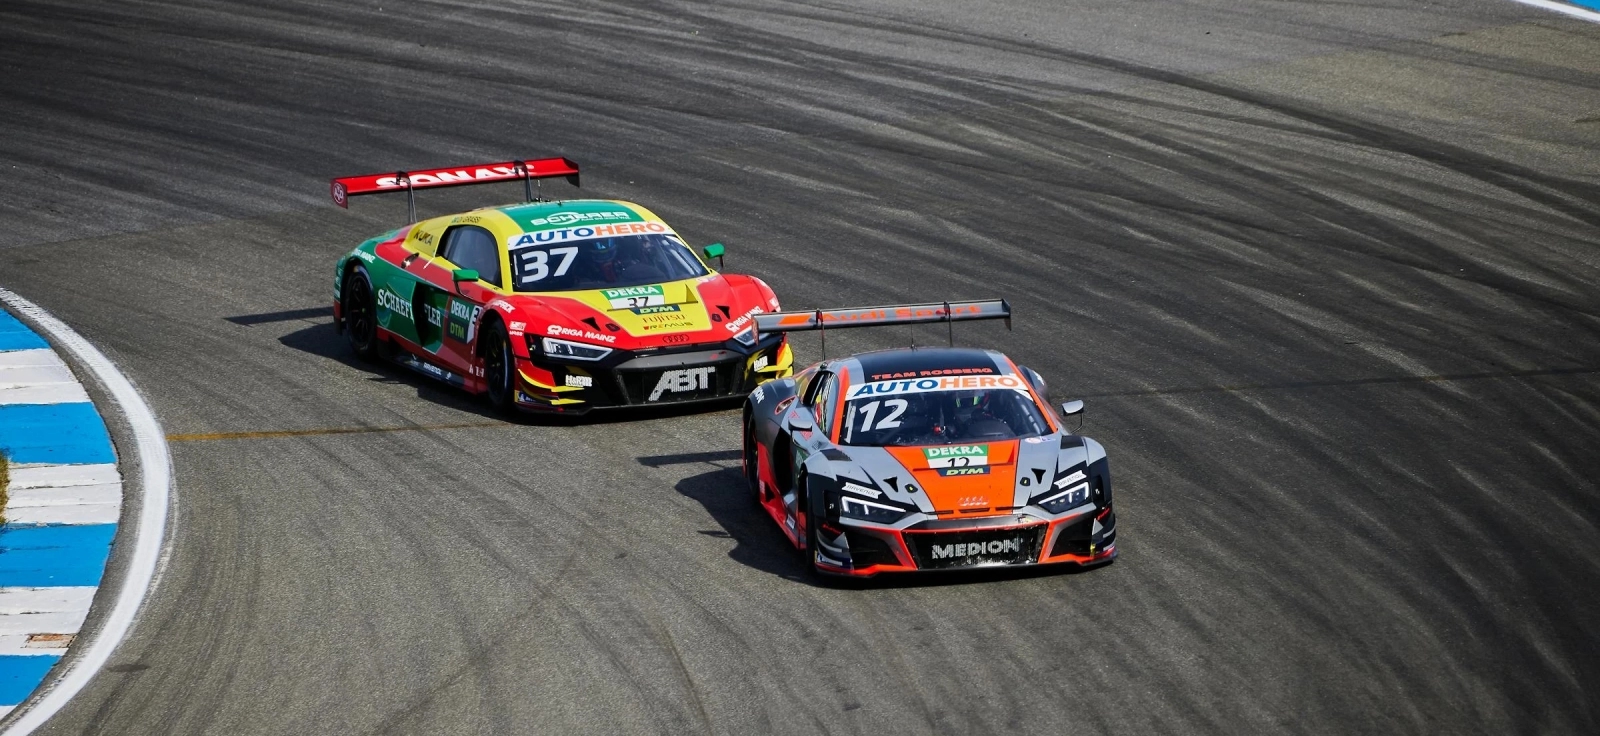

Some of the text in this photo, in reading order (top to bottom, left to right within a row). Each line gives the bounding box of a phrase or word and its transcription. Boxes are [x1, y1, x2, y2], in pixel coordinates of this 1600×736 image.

[413, 229, 434, 246] KUKA
[515, 223, 665, 246] AUTOHERO
[520, 246, 579, 283] 37
[607, 286, 659, 298] DEKRA
[451, 299, 470, 321] DEKRA
[627, 297, 649, 308] 37
[640, 306, 675, 314] DTM
[643, 313, 686, 323] FUJITSU
[824, 309, 885, 322] Audi
[450, 322, 465, 339] DTM
[650, 321, 693, 330] REMUS
[561, 326, 583, 338] RIGA
[584, 332, 616, 343] MAINZ
[871, 367, 993, 380] TEAM ROSBERG
[648, 366, 715, 401] ABT
[853, 375, 1020, 398] AUTOHERO
[858, 398, 908, 433] 12
[927, 445, 985, 457] DEKRA
[946, 467, 984, 476] DTM
[932, 539, 1021, 559] MEDION
